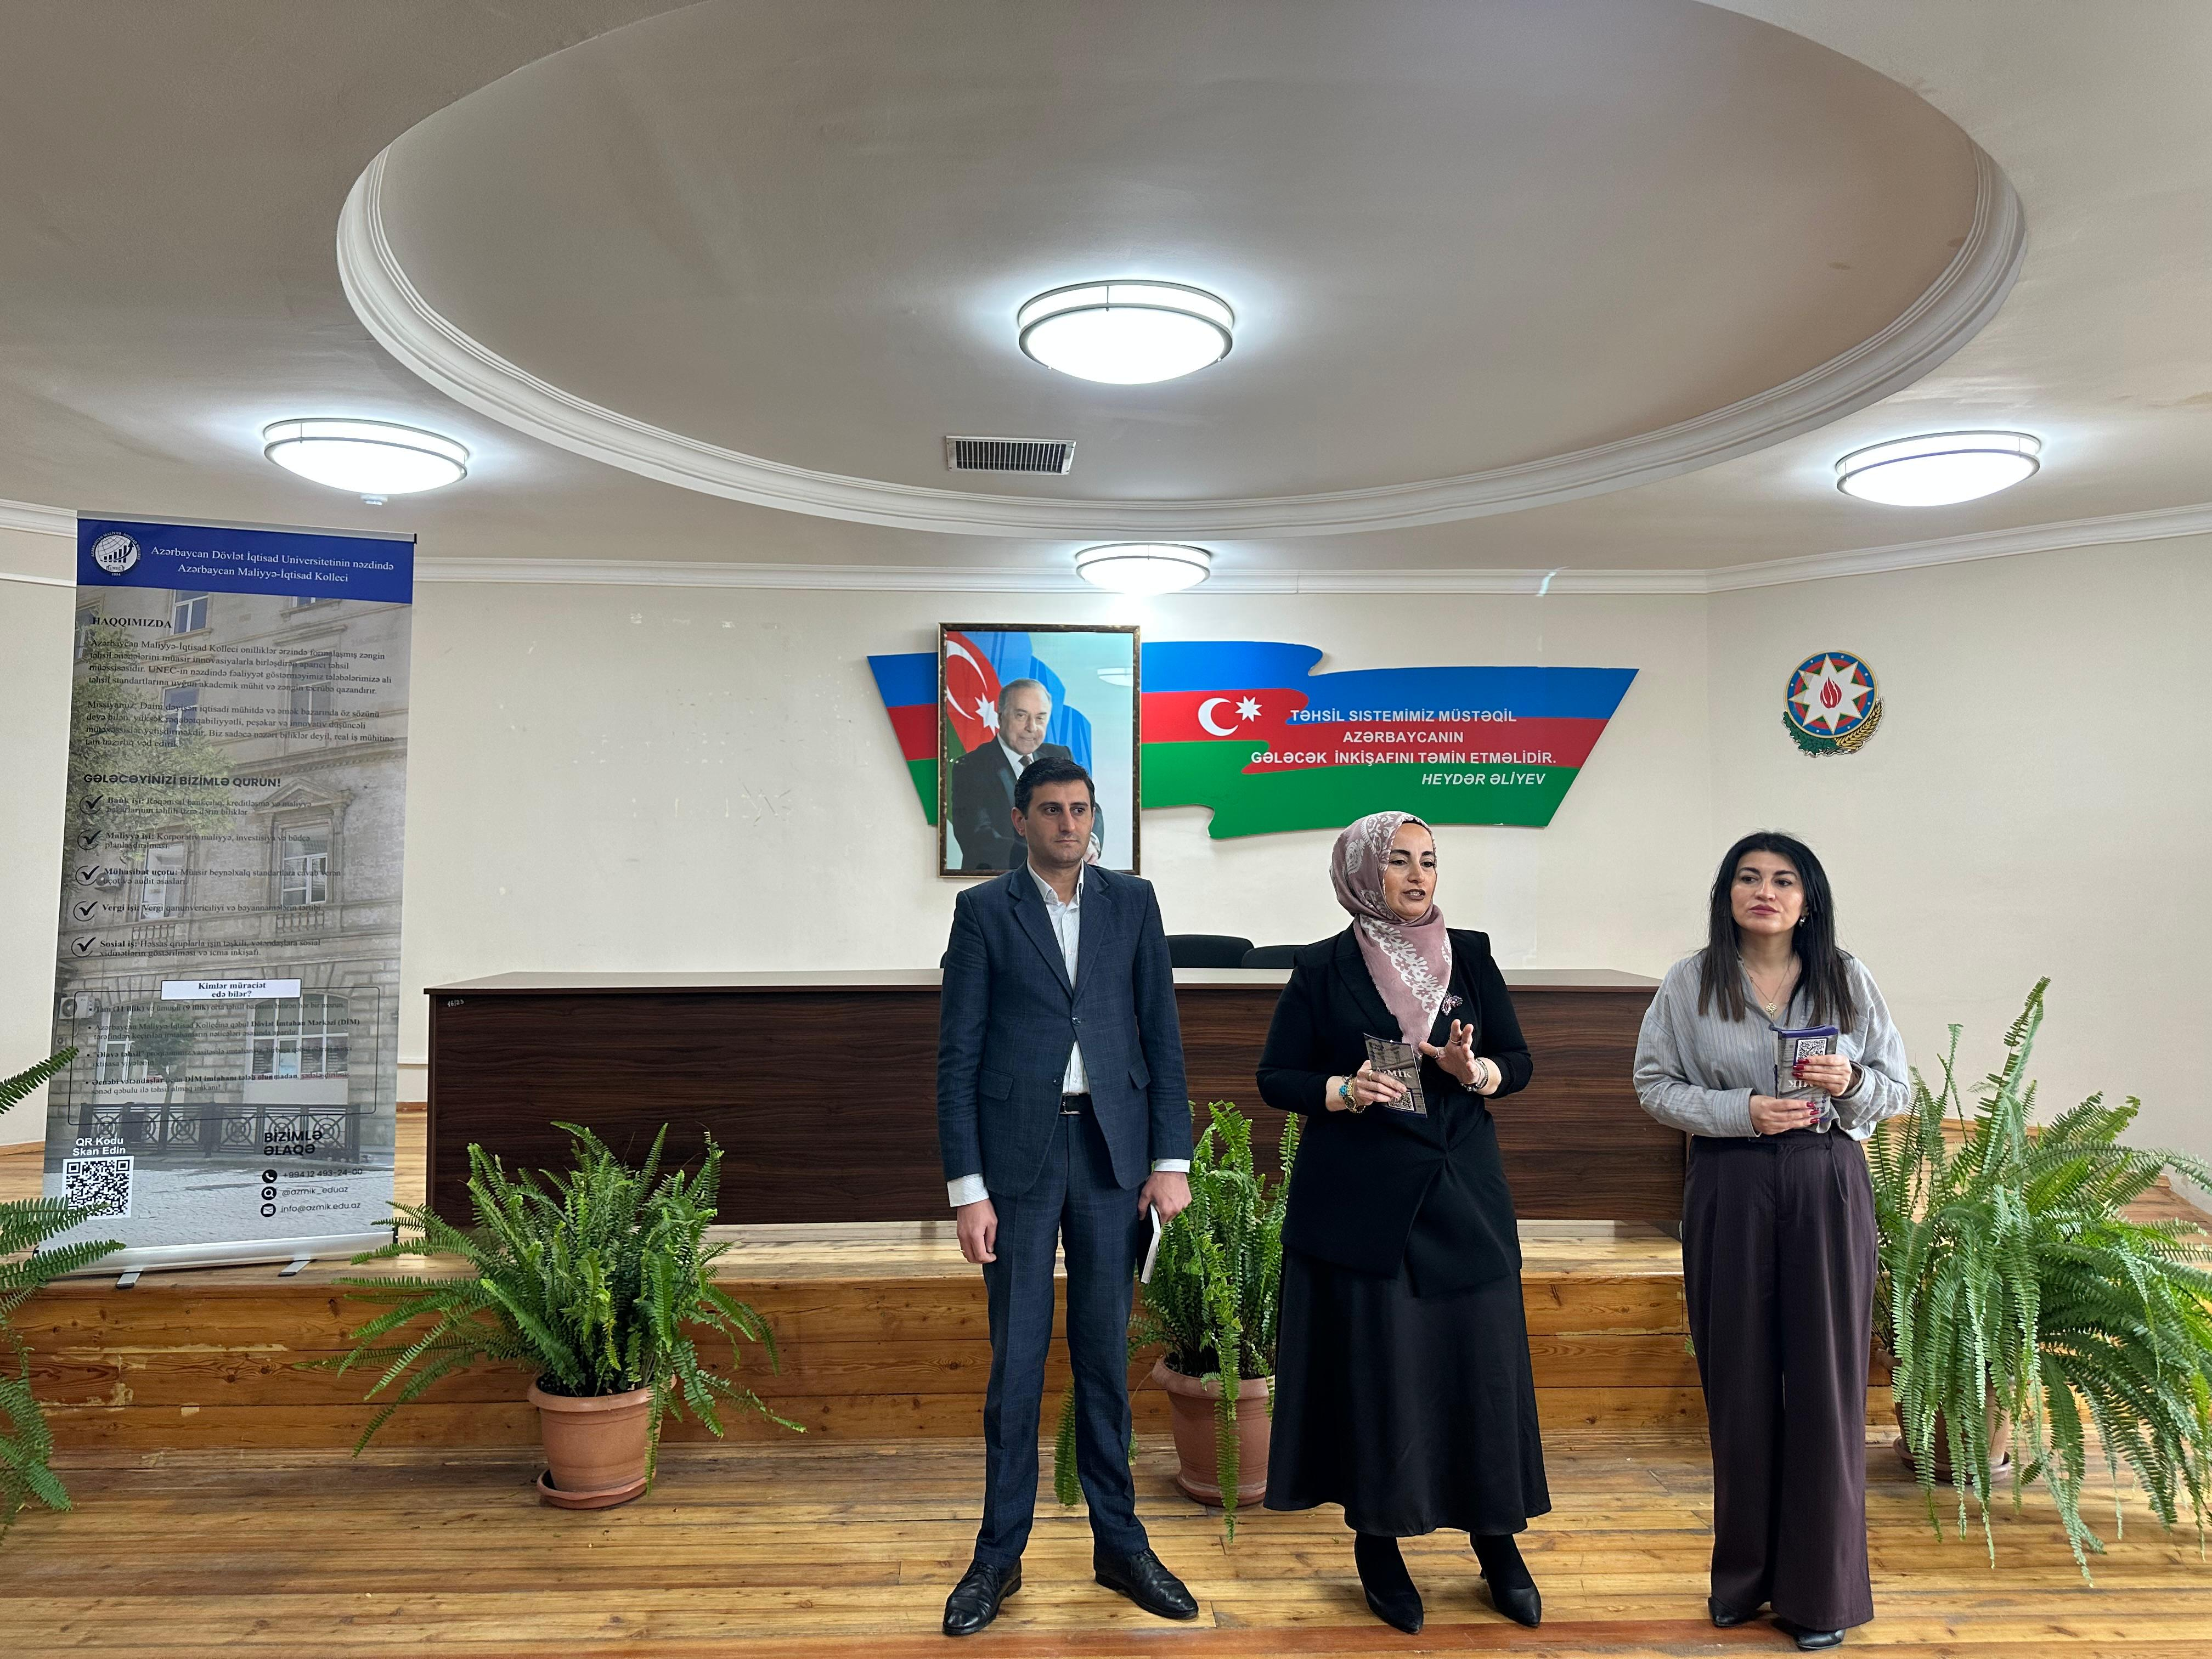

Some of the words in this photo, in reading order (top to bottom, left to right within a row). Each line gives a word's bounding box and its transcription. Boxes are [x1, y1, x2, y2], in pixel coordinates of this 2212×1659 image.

[151, 546, 208, 559] Azərbaycan
[212, 550, 244, 560] Dövlət
[247, 551, 279, 563] İqtisad
[282, 555, 350, 567] Universitetinin
[353, 561, 394, 571] nəzdində
[178, 564, 234, 576] Azərbaycan
[238, 567, 312, 580] Maliyyə-İqtisad
[315, 572, 348, 582] Kolleci
[92, 617, 172, 628] HAQQIMIZDA
[91, 640, 138, 648] Azərbaycan
[142, 641, 207, 652] Maliyyə-İqtisad
[241, 646, 276, 654] onilliklər
[310, 650, 357, 658] formalaşmış
[359, 652, 385, 661] zəngin
[193, 656, 253, 666] innovasiyalarla
[256, 659, 297, 668] birləşdirən
[300, 662, 325, 670] aparıcı
[229, 670, 263, 679] fəaliyyət
[266, 672, 324, 681] göstərməyimiz
[326, 674, 380, 683] tələbələrimizə
[112, 678, 168, 686] standartlarına
[277, 684, 303, 692] zəngin
[336, 686, 377, 695] qazandırır.
[200, 706, 229, 714] iqtisadi
[1290, 708, 1345, 722] TƏHSİL
[1349, 708, 1435, 722] SISTEMİMİZ
[1439, 708, 1517, 723] MÜSTƏQİL
[246, 719, 275, 727] peşəkar
[329, 721, 366, 730] düşüncəli
[310, 732, 332, 741] deyil,
[1342, 731, 1464, 743] AZƏRBAYCANIN
[1251, 752, 1327, 764] GƏLƏCƏK
[1334, 749, 1414, 766] İNKİŞAFINI
[1418, 750, 1466, 764] TƏMİN
[1470, 750, 1556, 764] ETMƏLİDİR.
[84, 774, 176, 784] GƏLƏCƏYİNİZİ
[179, 775, 229, 786] BİZİMLƏ
[233, 777, 281, 787] QURUN!
[1421, 774, 1486, 785] HEYDƏR
[1489, 771, 1546, 785] ƏLİYEV
[338, 1018, 359, 1026] (DİM)
[76, 1137, 93, 1146] QR
[95, 1137, 123, 1146] Kodu
[264, 1129, 323, 1142] BİZİMLƏ
[102, 1147, 126, 1155] Edin
[264, 1144, 315, 1156] ƏLAQƏ
[317, 1169, 363, 1177] 493-24-00
[282, 1187, 348, 1197] @azmik_eduaz
[281, 1202, 360, 1213] info@azmik.edu.az
